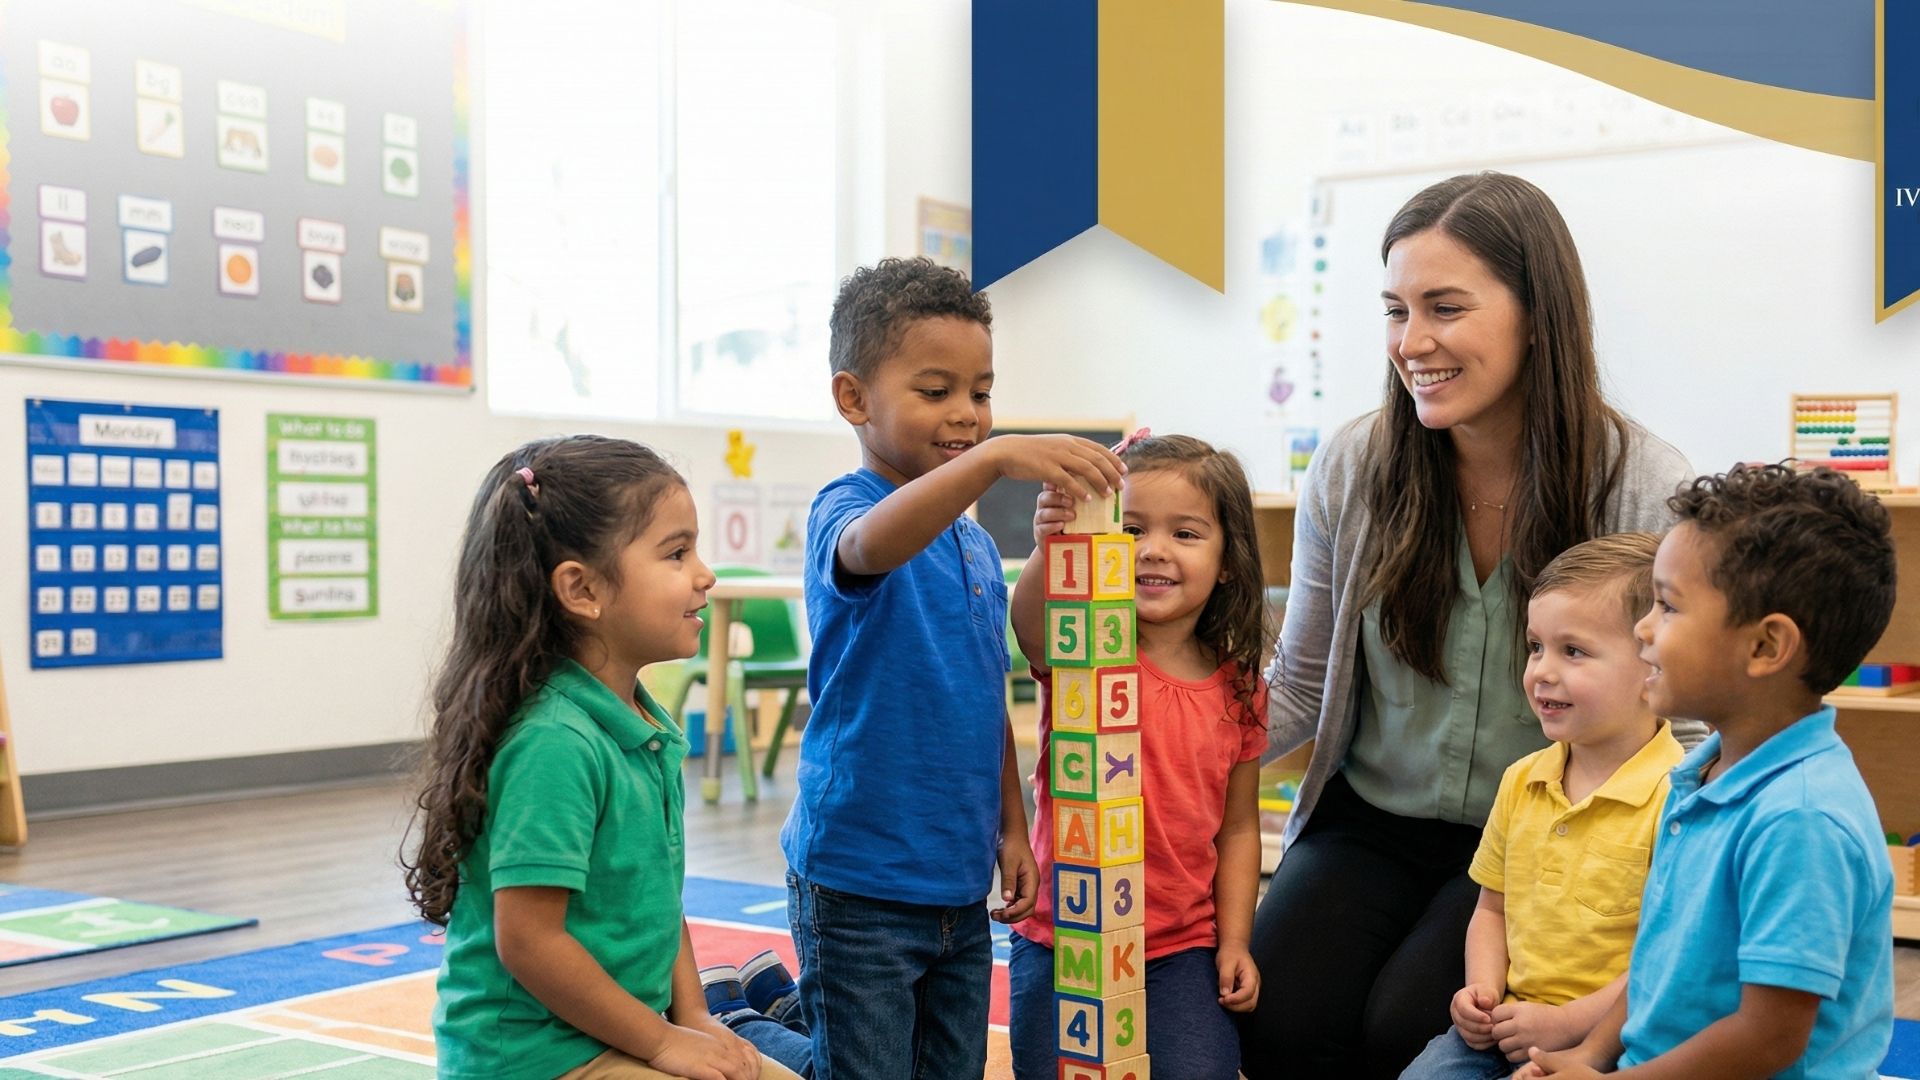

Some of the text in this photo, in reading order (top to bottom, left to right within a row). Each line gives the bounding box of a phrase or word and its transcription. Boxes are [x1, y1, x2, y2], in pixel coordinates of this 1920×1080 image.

[95, 422, 162, 443] Monday
[1062, 549, 1077, 588] 1
[1103, 548, 1122, 586] 2
[1057, 615, 1077, 654] 5
[1103, 614, 1122, 654] 3
[1064, 680, 1085, 718] 6
[1109, 680, 1130, 719] 5
[1062, 752, 1085, 781] C
[1063, 813, 1092, 854] A
[1109, 811, 1133, 852] H
[1066, 879, 1088, 915] J
[1113, 878, 1132, 916] 3
[1062, 944, 1094, 984] M
[1113, 941, 1136, 982] K
[1067, 1009, 1090, 1047] 4
[1115, 1007, 1135, 1046] 3
